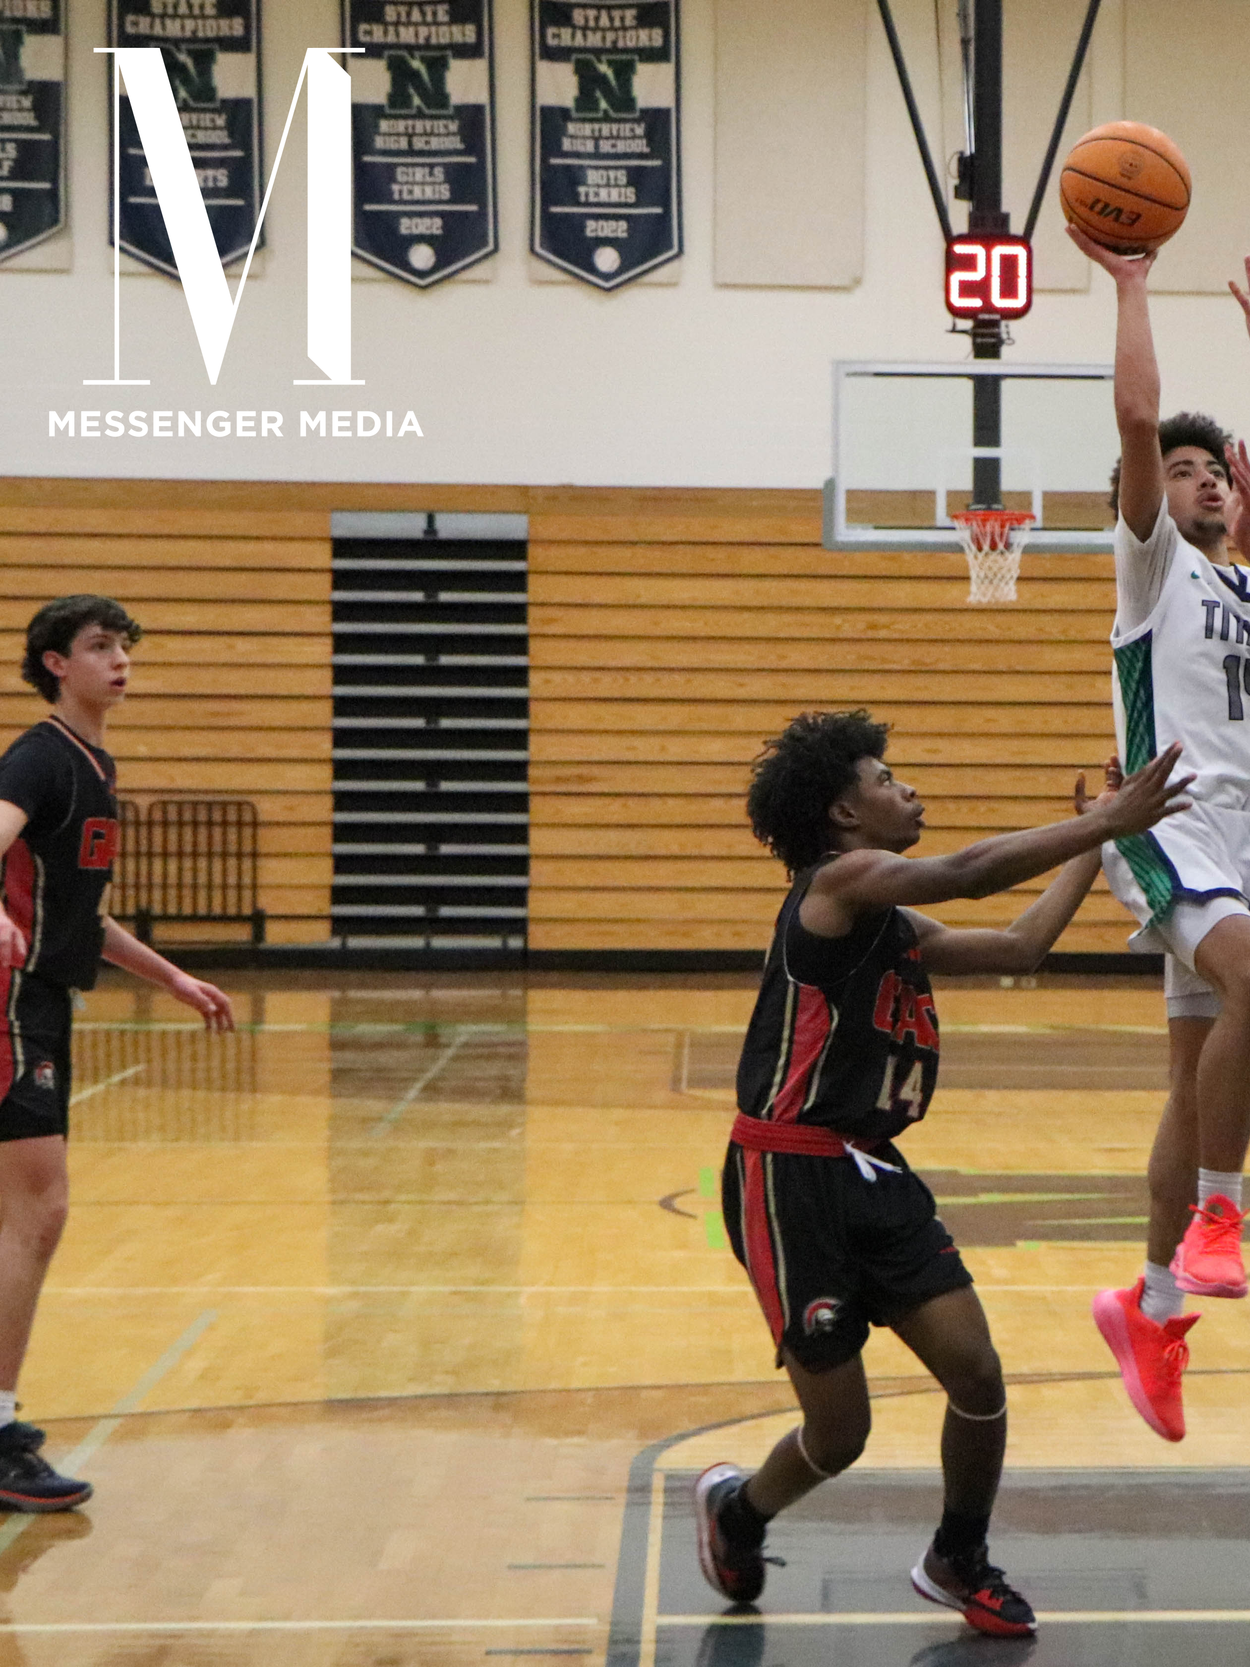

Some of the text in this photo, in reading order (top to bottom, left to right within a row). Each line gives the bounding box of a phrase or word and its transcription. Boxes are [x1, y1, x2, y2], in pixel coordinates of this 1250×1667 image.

[153, 0, 218, 15] STATE
[384, 4, 449, 23] STATE
[124, 15, 245, 37] CHAMPIONS
[572, 8, 638, 27] STATE
[358, 23, 477, 44] CHAMPIONS
[546, 27, 663, 48] CHAMPIONS
[384, 51, 453, 114] N
[571, 54, 640, 118] N
[379, 119, 459, 134] NORTHVIEW
[567, 122, 645, 137] NORTHVIEW
[412, 135, 465, 150] SCHOOL
[599, 138, 650, 153] SCHOOL
[396, 166, 444, 182] GIRLS
[586, 169, 628, 185] BOYS
[391, 184, 450, 200] TENNIS
[578, 186, 636, 203] TENNIS
[400, 217, 443, 235] 2022
[586, 220, 628, 238] 2022
[950, 244, 1027, 308] 20
[875, 1054, 923, 1119] 14
